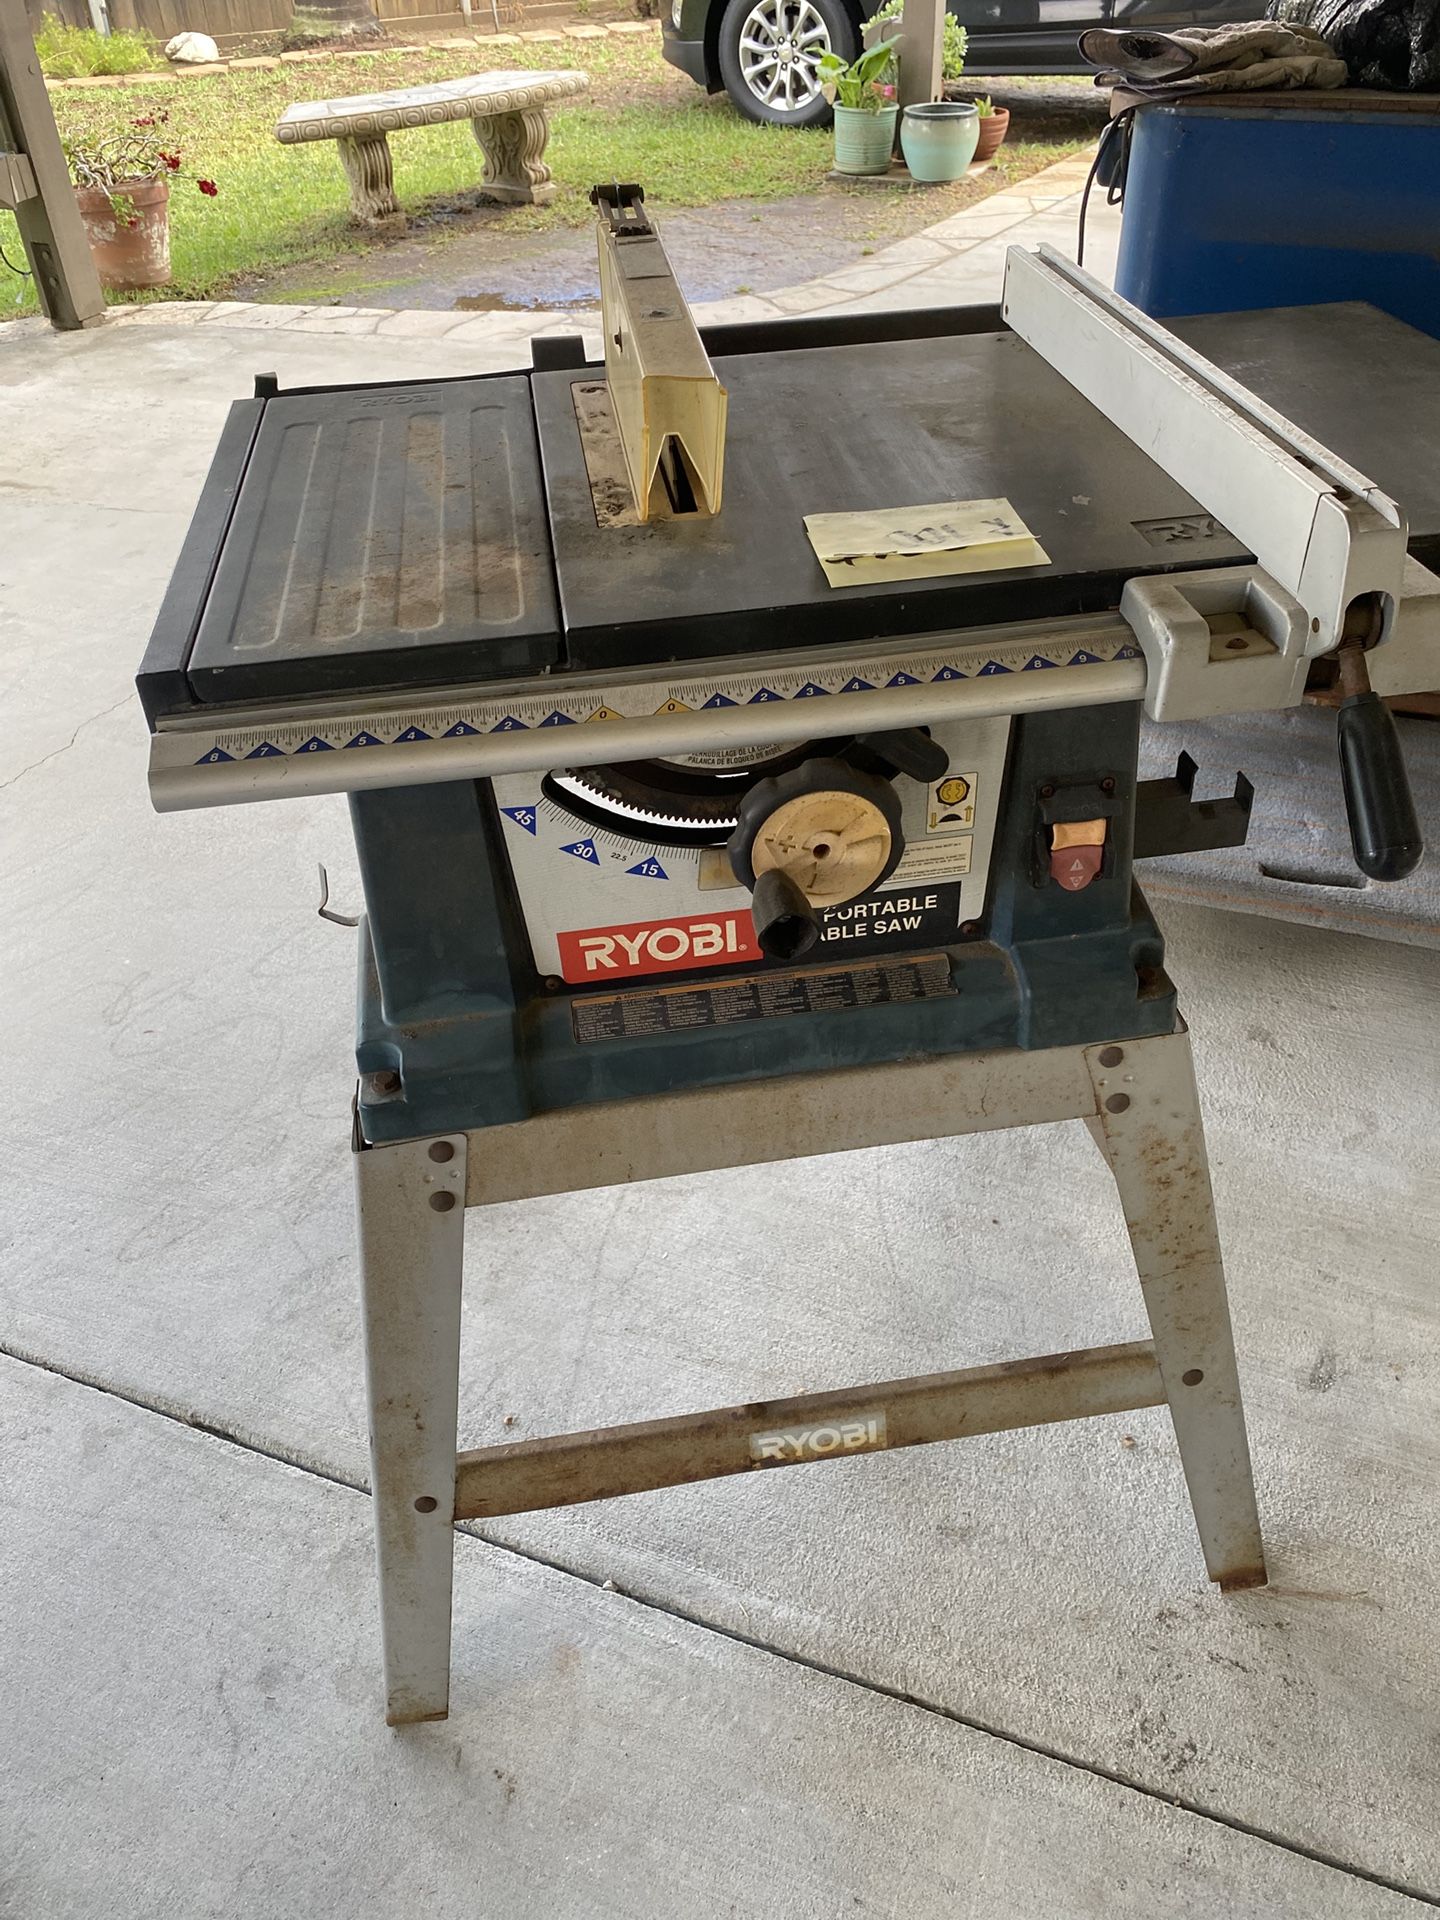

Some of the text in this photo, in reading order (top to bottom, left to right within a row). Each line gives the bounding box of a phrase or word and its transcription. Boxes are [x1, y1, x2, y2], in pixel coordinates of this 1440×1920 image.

[210, 649, 1135, 762] 8 7 6 5 4 3 2 1 0 0 1 2 3 4 5 6 7 8 9 10
[687, 756, 716, 766] PALANCA
[716, 757, 725, 766] DE
[513, 809, 535, 826] 45
[572, 843, 593, 859] 30
[610, 851, 628, 862] 22.5
[641, 863, 659, 876] 15
[823, 894, 938, 923] PORTABLE
[873, 915, 922, 935] SAW
[757, 1420, 878, 1460] RYOBI
